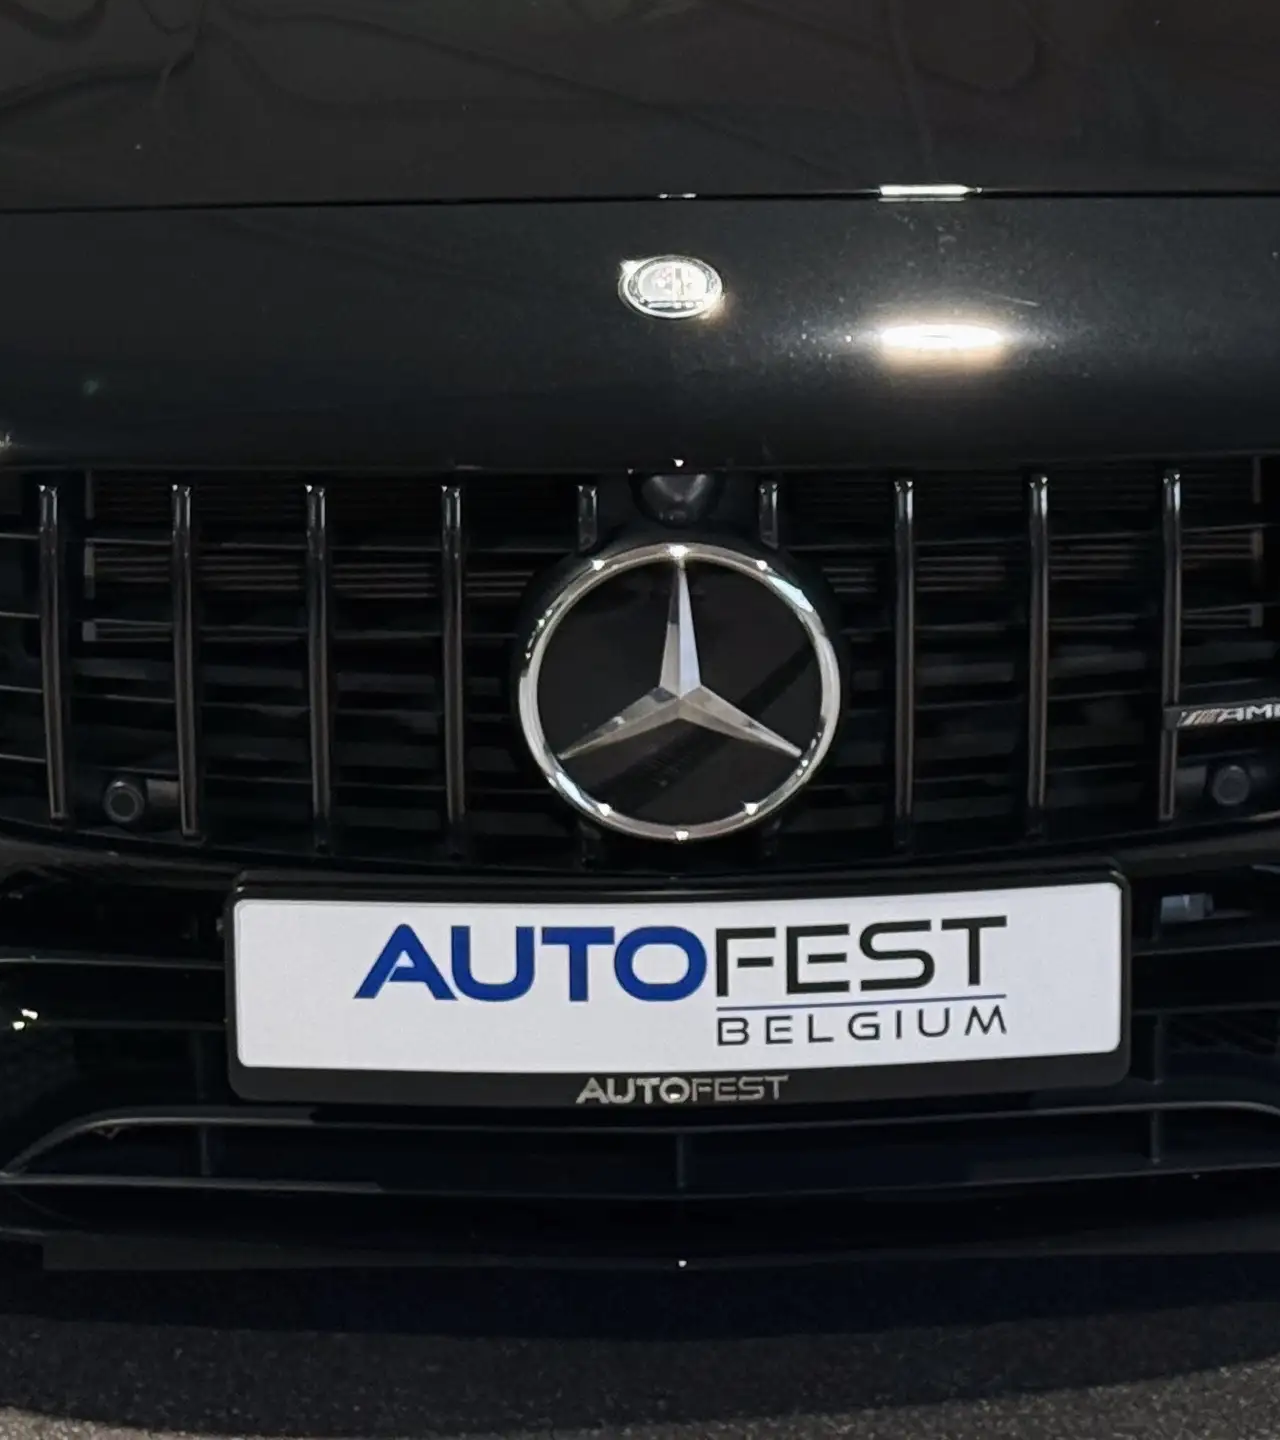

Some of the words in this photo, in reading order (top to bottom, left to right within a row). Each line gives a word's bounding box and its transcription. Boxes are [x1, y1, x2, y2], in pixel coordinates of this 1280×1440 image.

[353, 915, 1007, 1003] AUTOFEST
[717, 1005, 1008, 1046] BELGIUM
[575, 1075, 789, 1105] AUTOFEST
